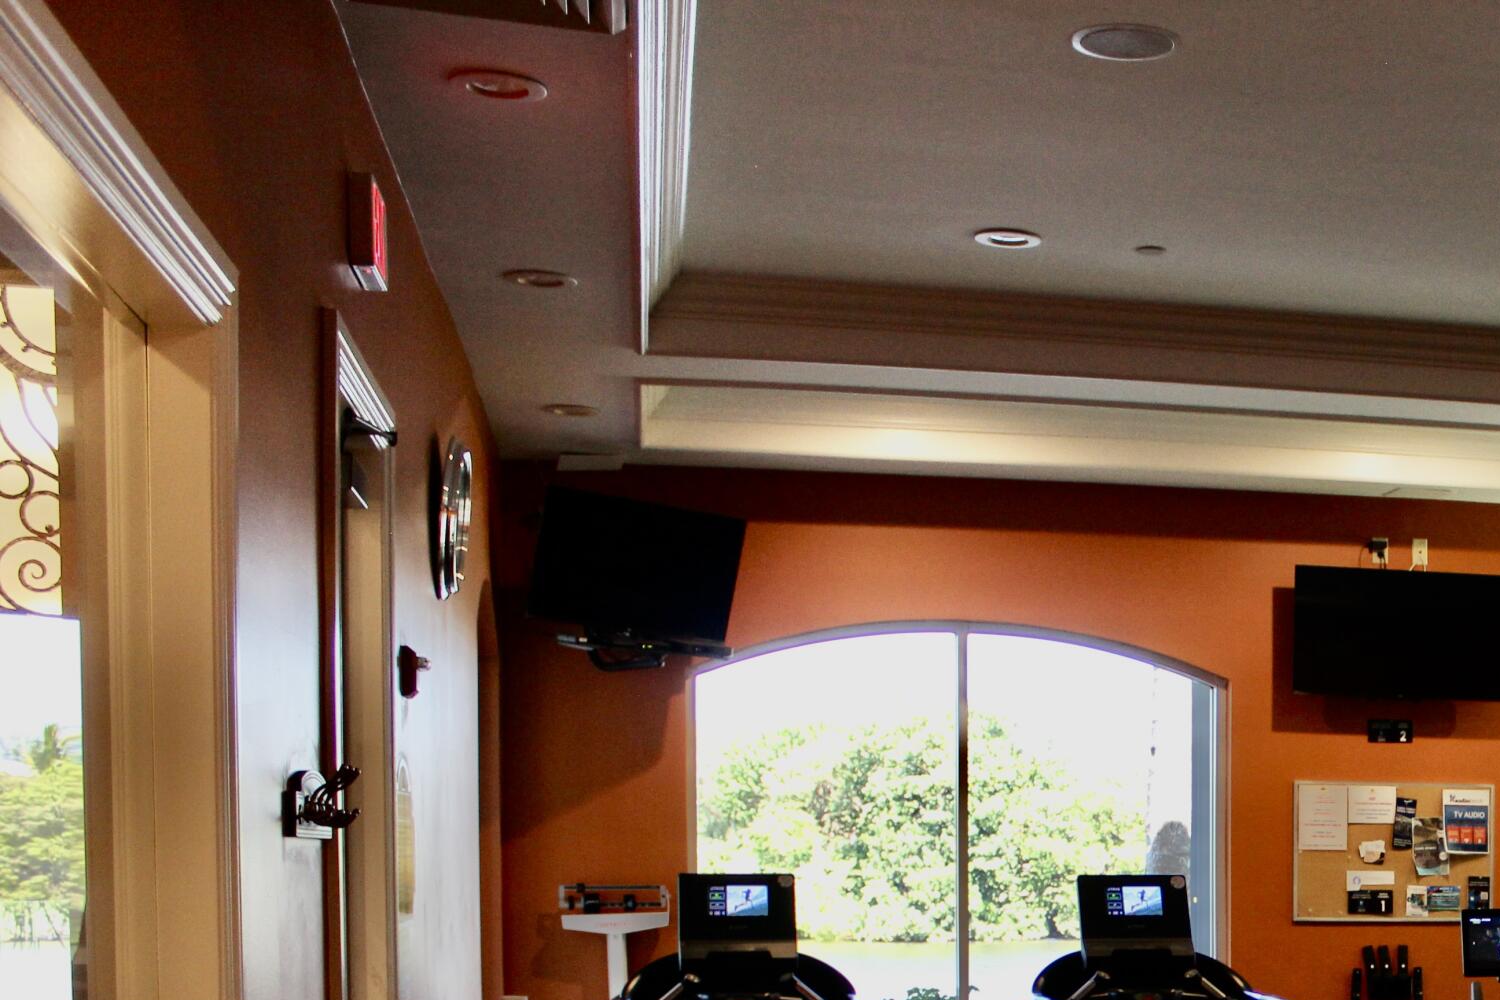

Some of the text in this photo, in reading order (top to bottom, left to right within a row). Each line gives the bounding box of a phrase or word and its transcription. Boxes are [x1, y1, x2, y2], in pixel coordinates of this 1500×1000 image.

[1400, 730, 1407, 742] 2
[1464, 811, 1485, 819] AUDIO
[1380, 900, 1386, 912] 1
